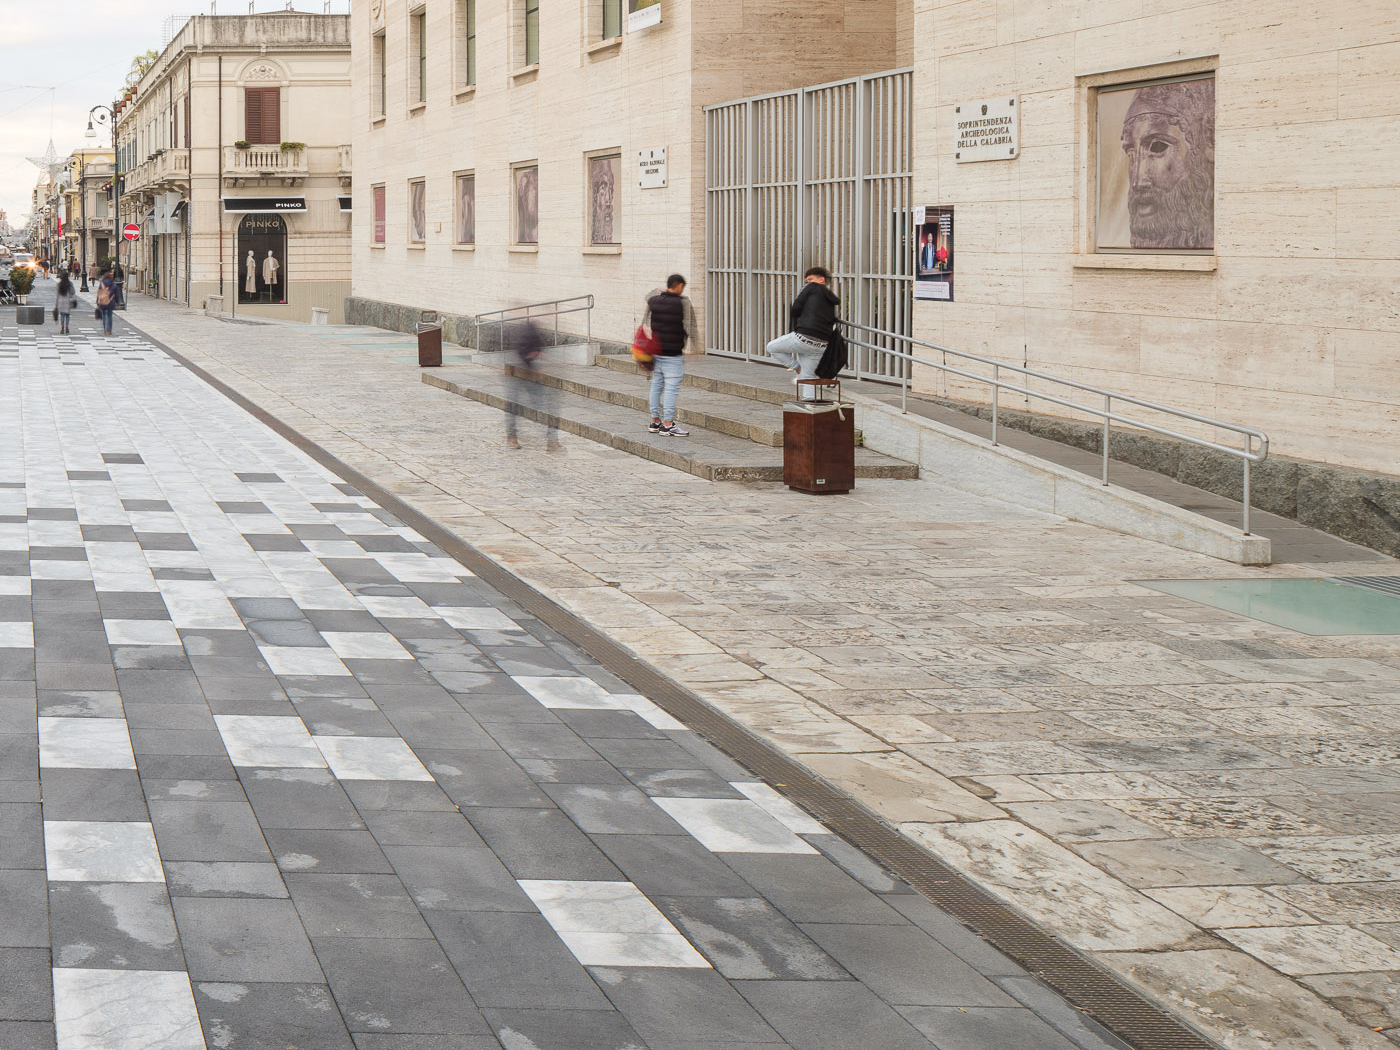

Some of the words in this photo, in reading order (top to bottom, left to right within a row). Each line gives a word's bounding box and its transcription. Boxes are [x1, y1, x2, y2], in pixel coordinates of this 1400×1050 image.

[957, 116, 1013, 130] SOPRINTENDENZA
[960, 126, 1010, 139] ARCHEOLOGICA
[957, 139, 978, 149] DELLA
[980, 136, 1013, 146] CALABRIA
